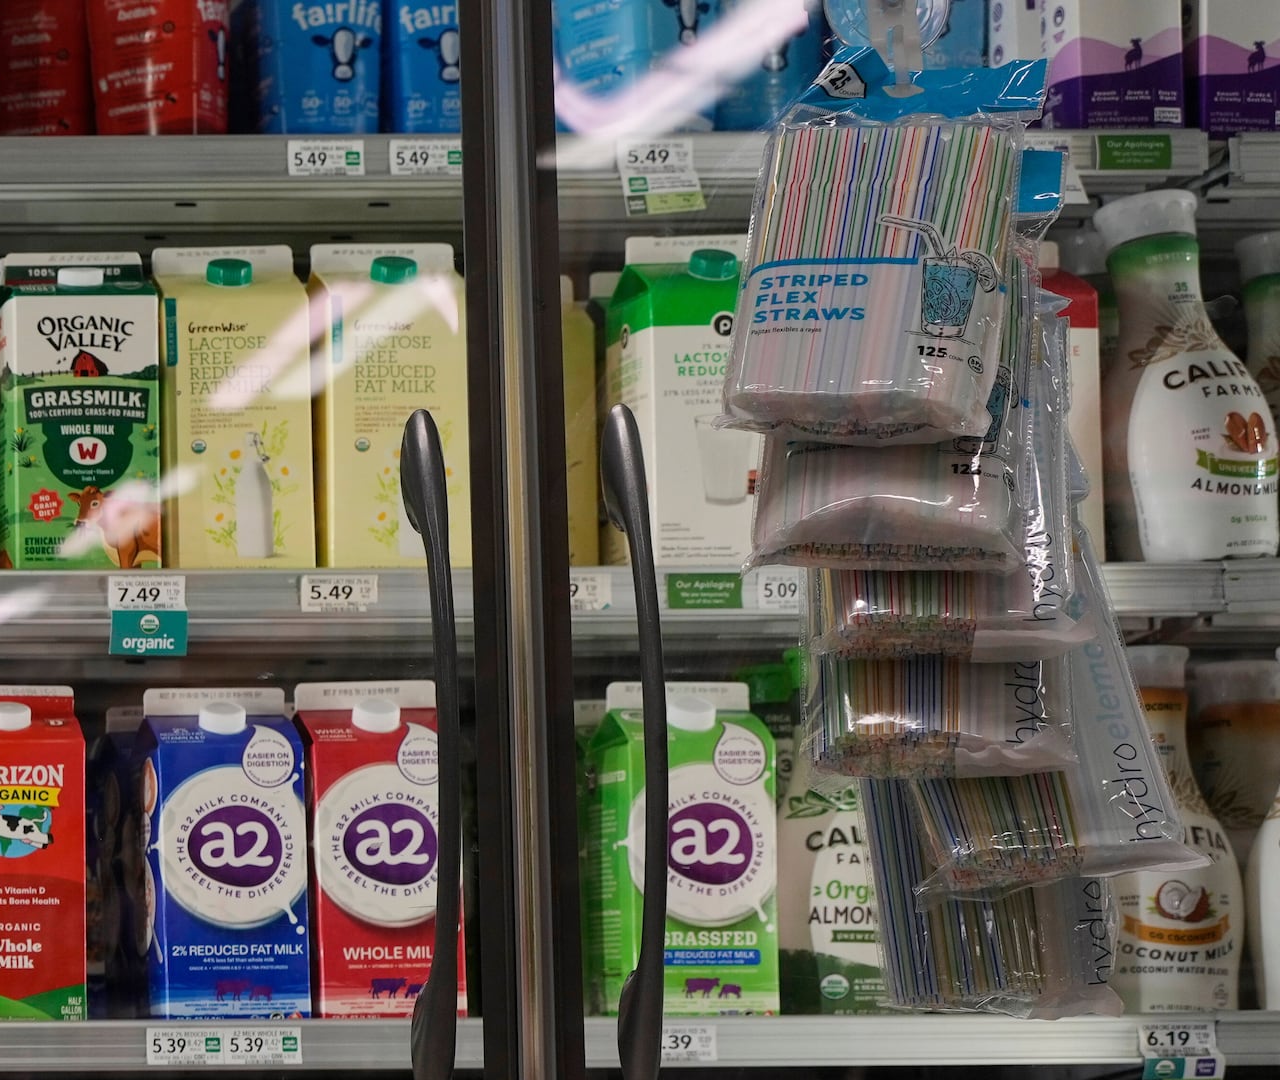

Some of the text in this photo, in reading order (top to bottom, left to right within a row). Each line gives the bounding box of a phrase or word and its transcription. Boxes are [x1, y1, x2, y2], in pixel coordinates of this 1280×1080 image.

[628, 149, 669, 164] 5.49
[759, 274, 869, 290] STRIPED
[1174, 282, 1189, 292] 35
[754, 291, 818, 307] FLEX
[753, 307, 866, 324] STRAWS
[37, 315, 135, 337] ORGANIC
[45, 332, 127, 352] VALLEY
[188, 336, 266, 351] LACTOSE
[189, 351, 233, 365] FREE
[355, 350, 398, 364] FREE
[675, 580, 735, 590] Our Apologies
[764, 583, 797, 598] 5.09
[118, 586, 161, 603] 7.49
[310, 585, 353, 601] 5.49
[246, 760, 291, 768] DIGESTION
[670, 817, 745, 865] a2
[9, 897, 30, 905] Bone
[32, 896, 60, 905] Health
[153, 1038, 186, 1053] 5.39
[230, 1038, 264, 1053] 5.39
[1147, 1031, 1190, 1046] 6.19
